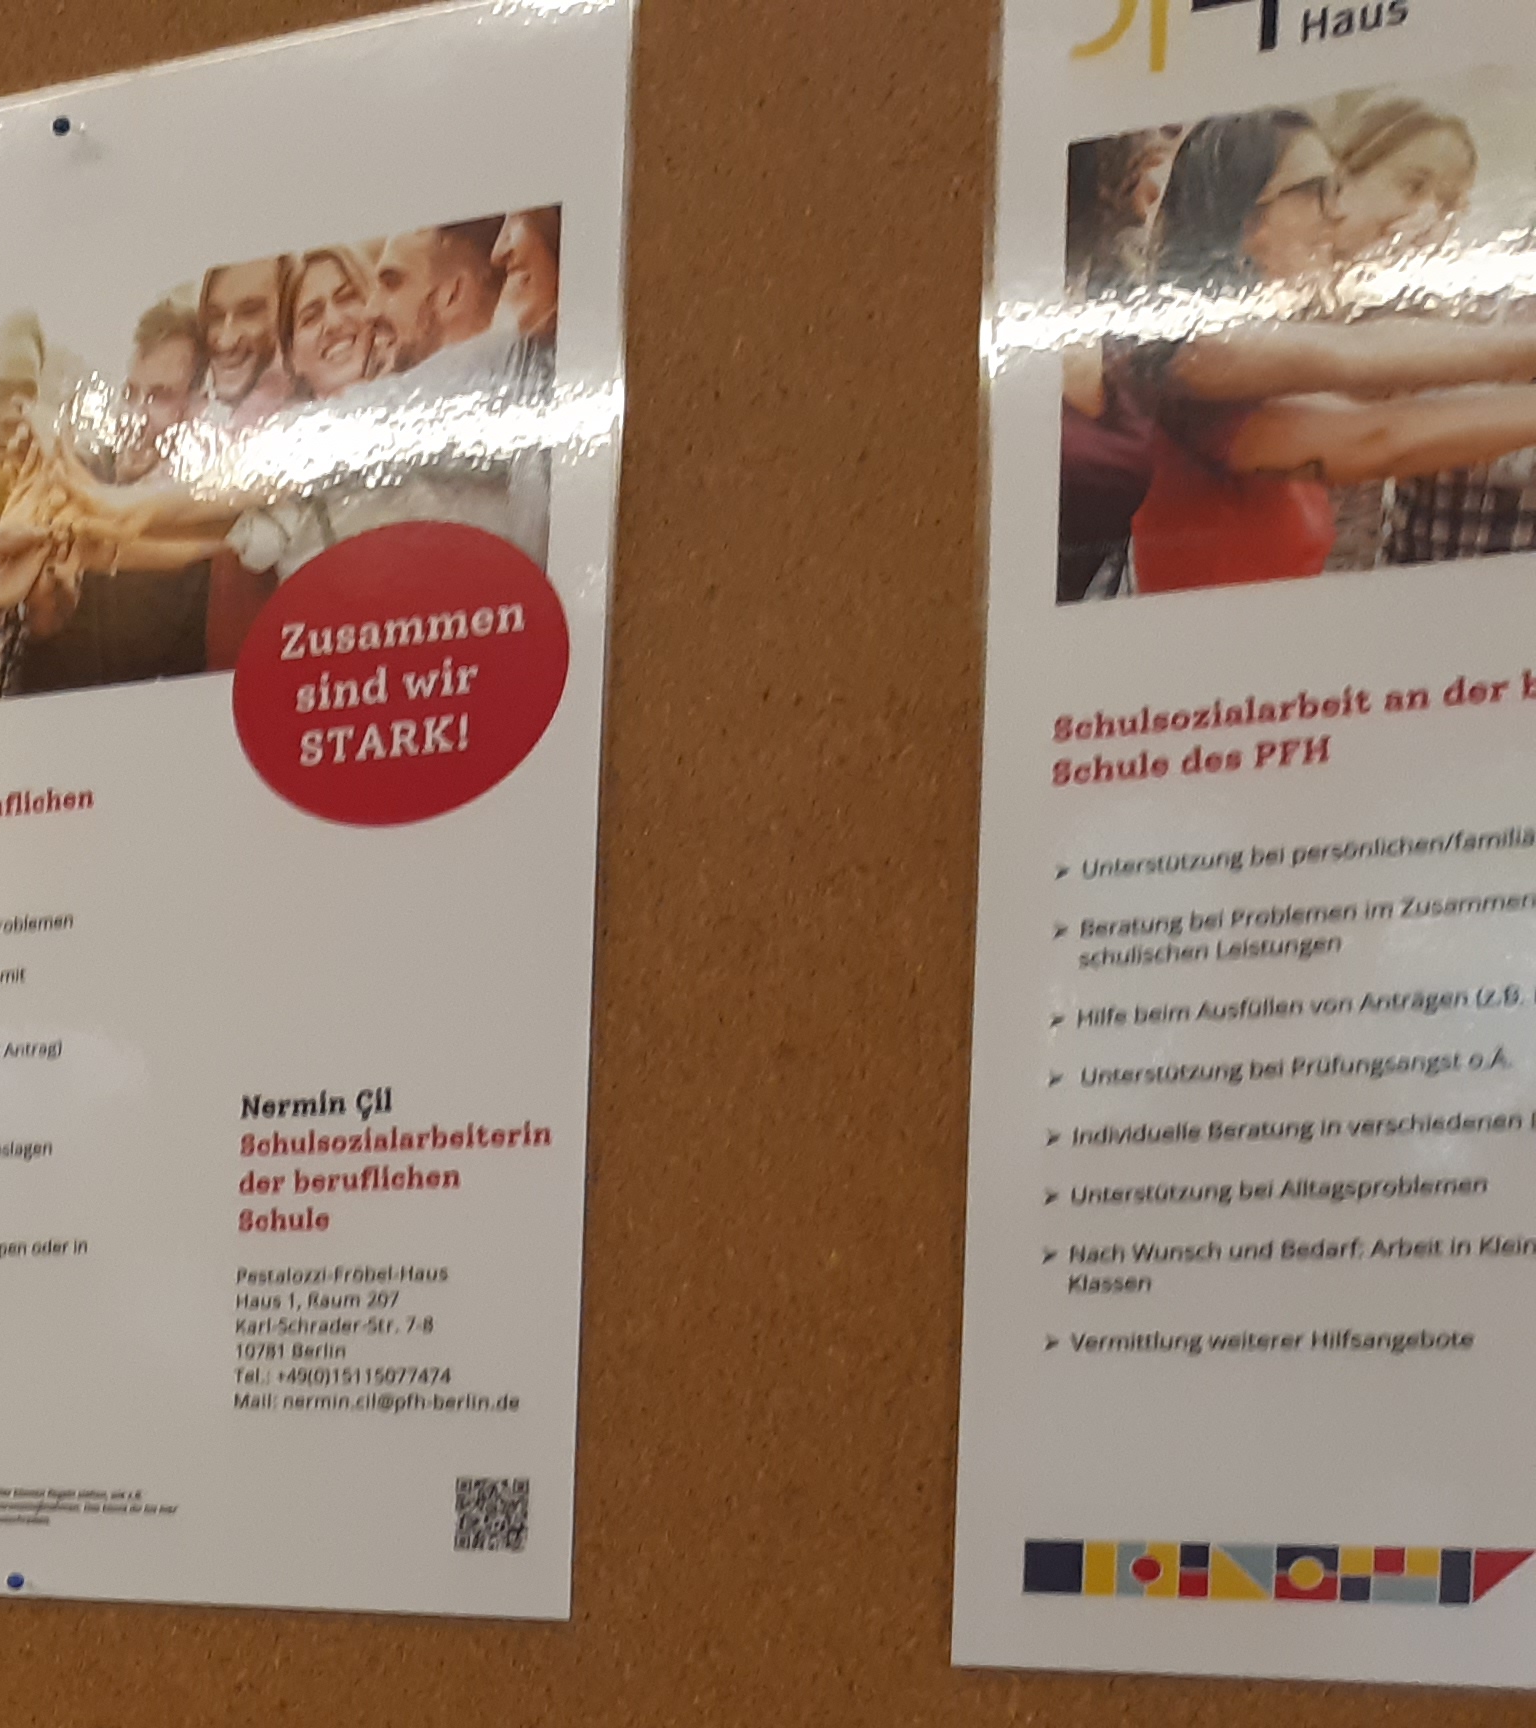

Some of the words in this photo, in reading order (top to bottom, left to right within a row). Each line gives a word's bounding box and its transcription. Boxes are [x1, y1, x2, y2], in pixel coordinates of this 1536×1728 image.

[1301, 0, 1409, 43] Haus
[279, 602, 525, 660] Zusammen
[294, 665, 388, 713] sind
[401, 656, 479, 700] wir
[1052, 686, 1371, 743] Schulsozialarbeit
[1383, 687, 1430, 713] an
[1442, 675, 1510, 707] der
[299, 712, 468, 767] STARK!
[1051, 750, 1169, 786] Schule
[1180, 744, 1242, 775] des
[1253, 734, 1331, 769] PFH
[240, 1089, 347, 1119] Nermin
[355, 1086, 392, 1121] Çil
[239, 1120, 551, 1156] Schulsozialarbeiterin
[238, 1169, 286, 1195] der
[293, 1164, 460, 1193] beruflichen
[1070, 1183, 1233, 1207] Unterstützung
[1238, 1179, 1274, 1201] bei
[1278, 1173, 1488, 1202] Alltagsproblemen
[237, 1206, 330, 1232] Schule
[1070, 1329, 1203, 1355] Vermittlung
[1207, 1331, 1304, 1351] weiterer
[1310, 1328, 1474, 1354] Hilfsangebote
